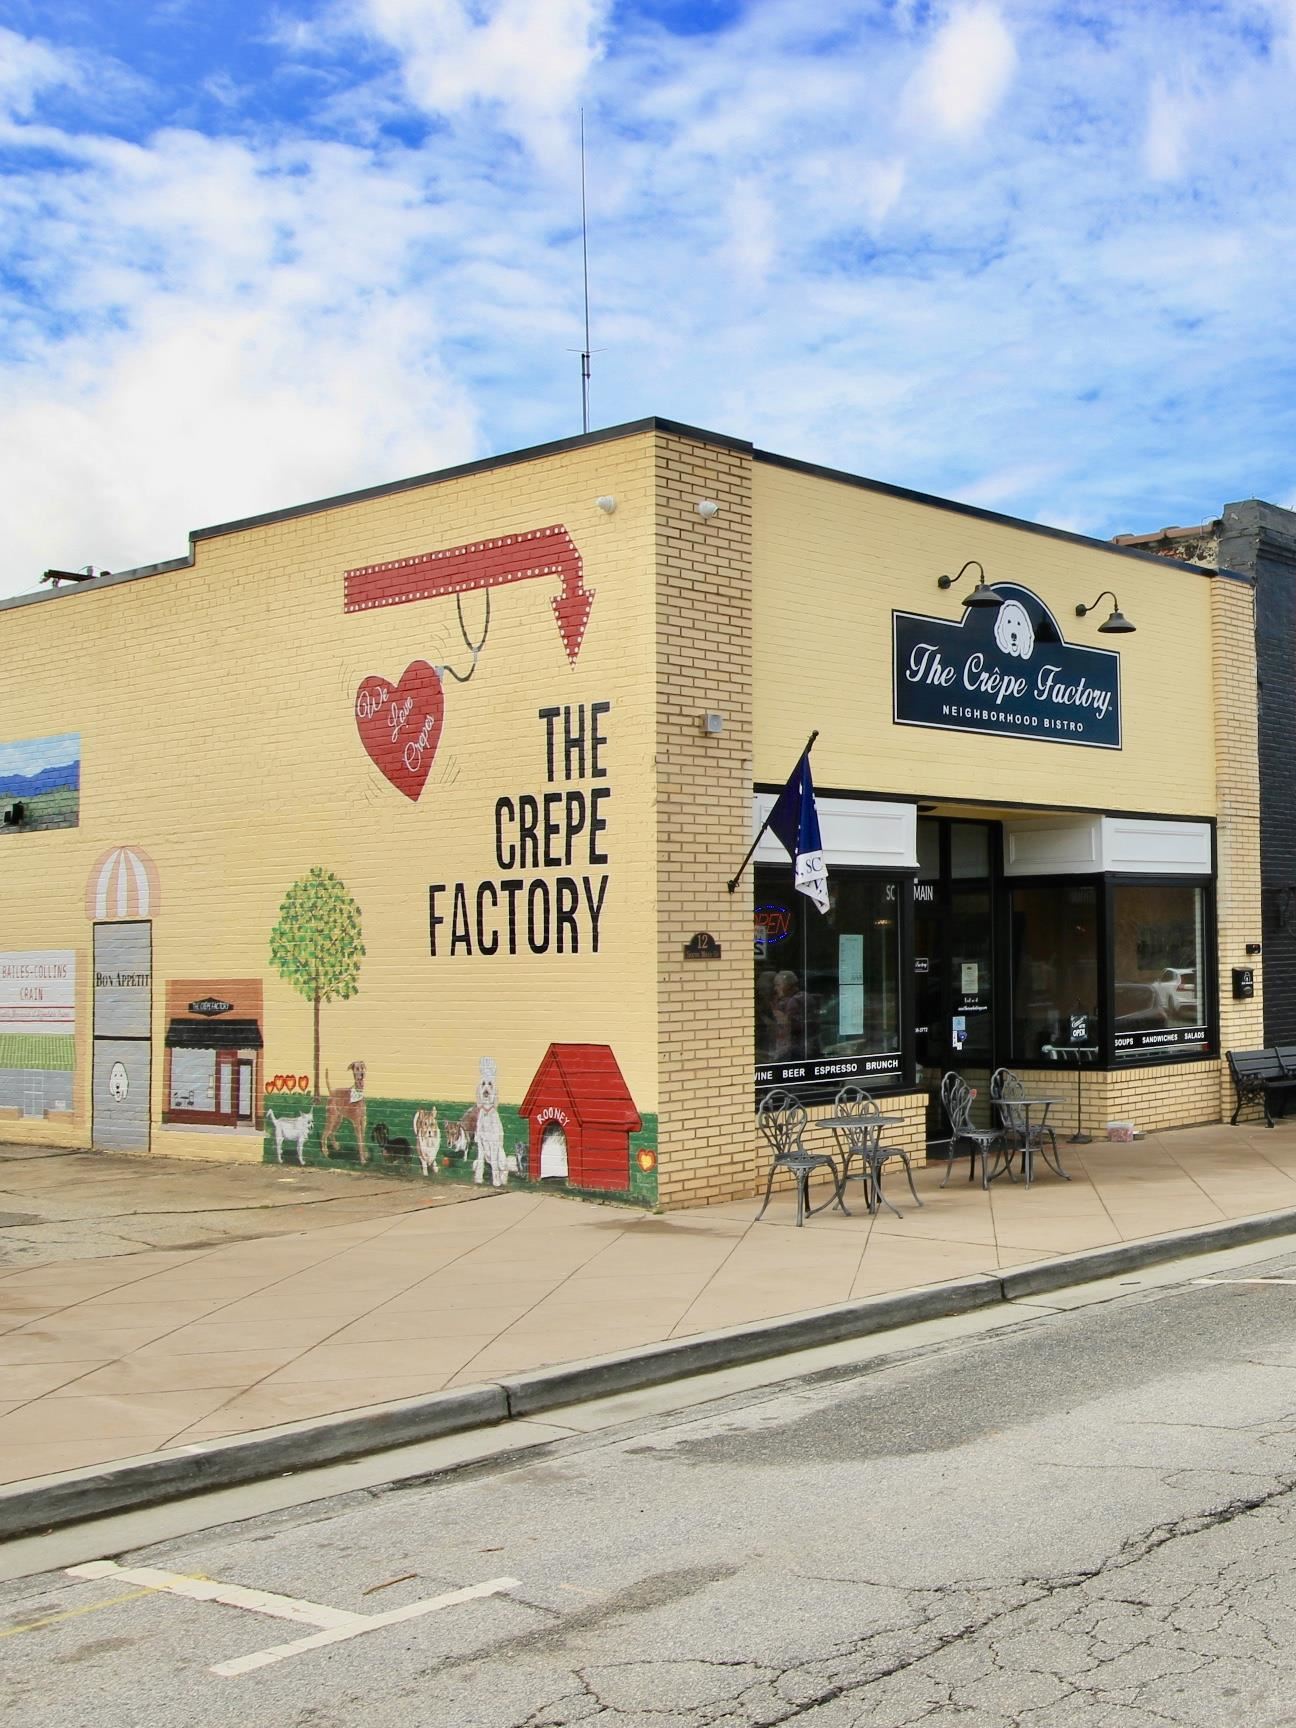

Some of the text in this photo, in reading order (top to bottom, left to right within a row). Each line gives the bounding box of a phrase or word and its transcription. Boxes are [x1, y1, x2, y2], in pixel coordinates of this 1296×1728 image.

[905, 643, 1113, 720] The Crêpe Factory
[357, 686, 390, 719] We
[387, 696, 414, 743] Love
[942, 704, 1085, 733] NEIGHBORHOOD BISTRO
[538, 701, 611, 782] THE
[495, 788, 611, 870] CREPE
[913, 885, 934, 901] MAIN
[429, 875, 609, 957] FACTORY
[697, 935, 708, 949] 12
[1114, 1031, 1205, 1047] SOUPS SANDWICHES SALADS
[782, 1068, 806, 1079] BEER
[814, 1063, 858, 1076] ESPRESSO
[865, 1060, 899, 1071] BRUNCH
[536, 1106, 570, 1127] ROONEY
